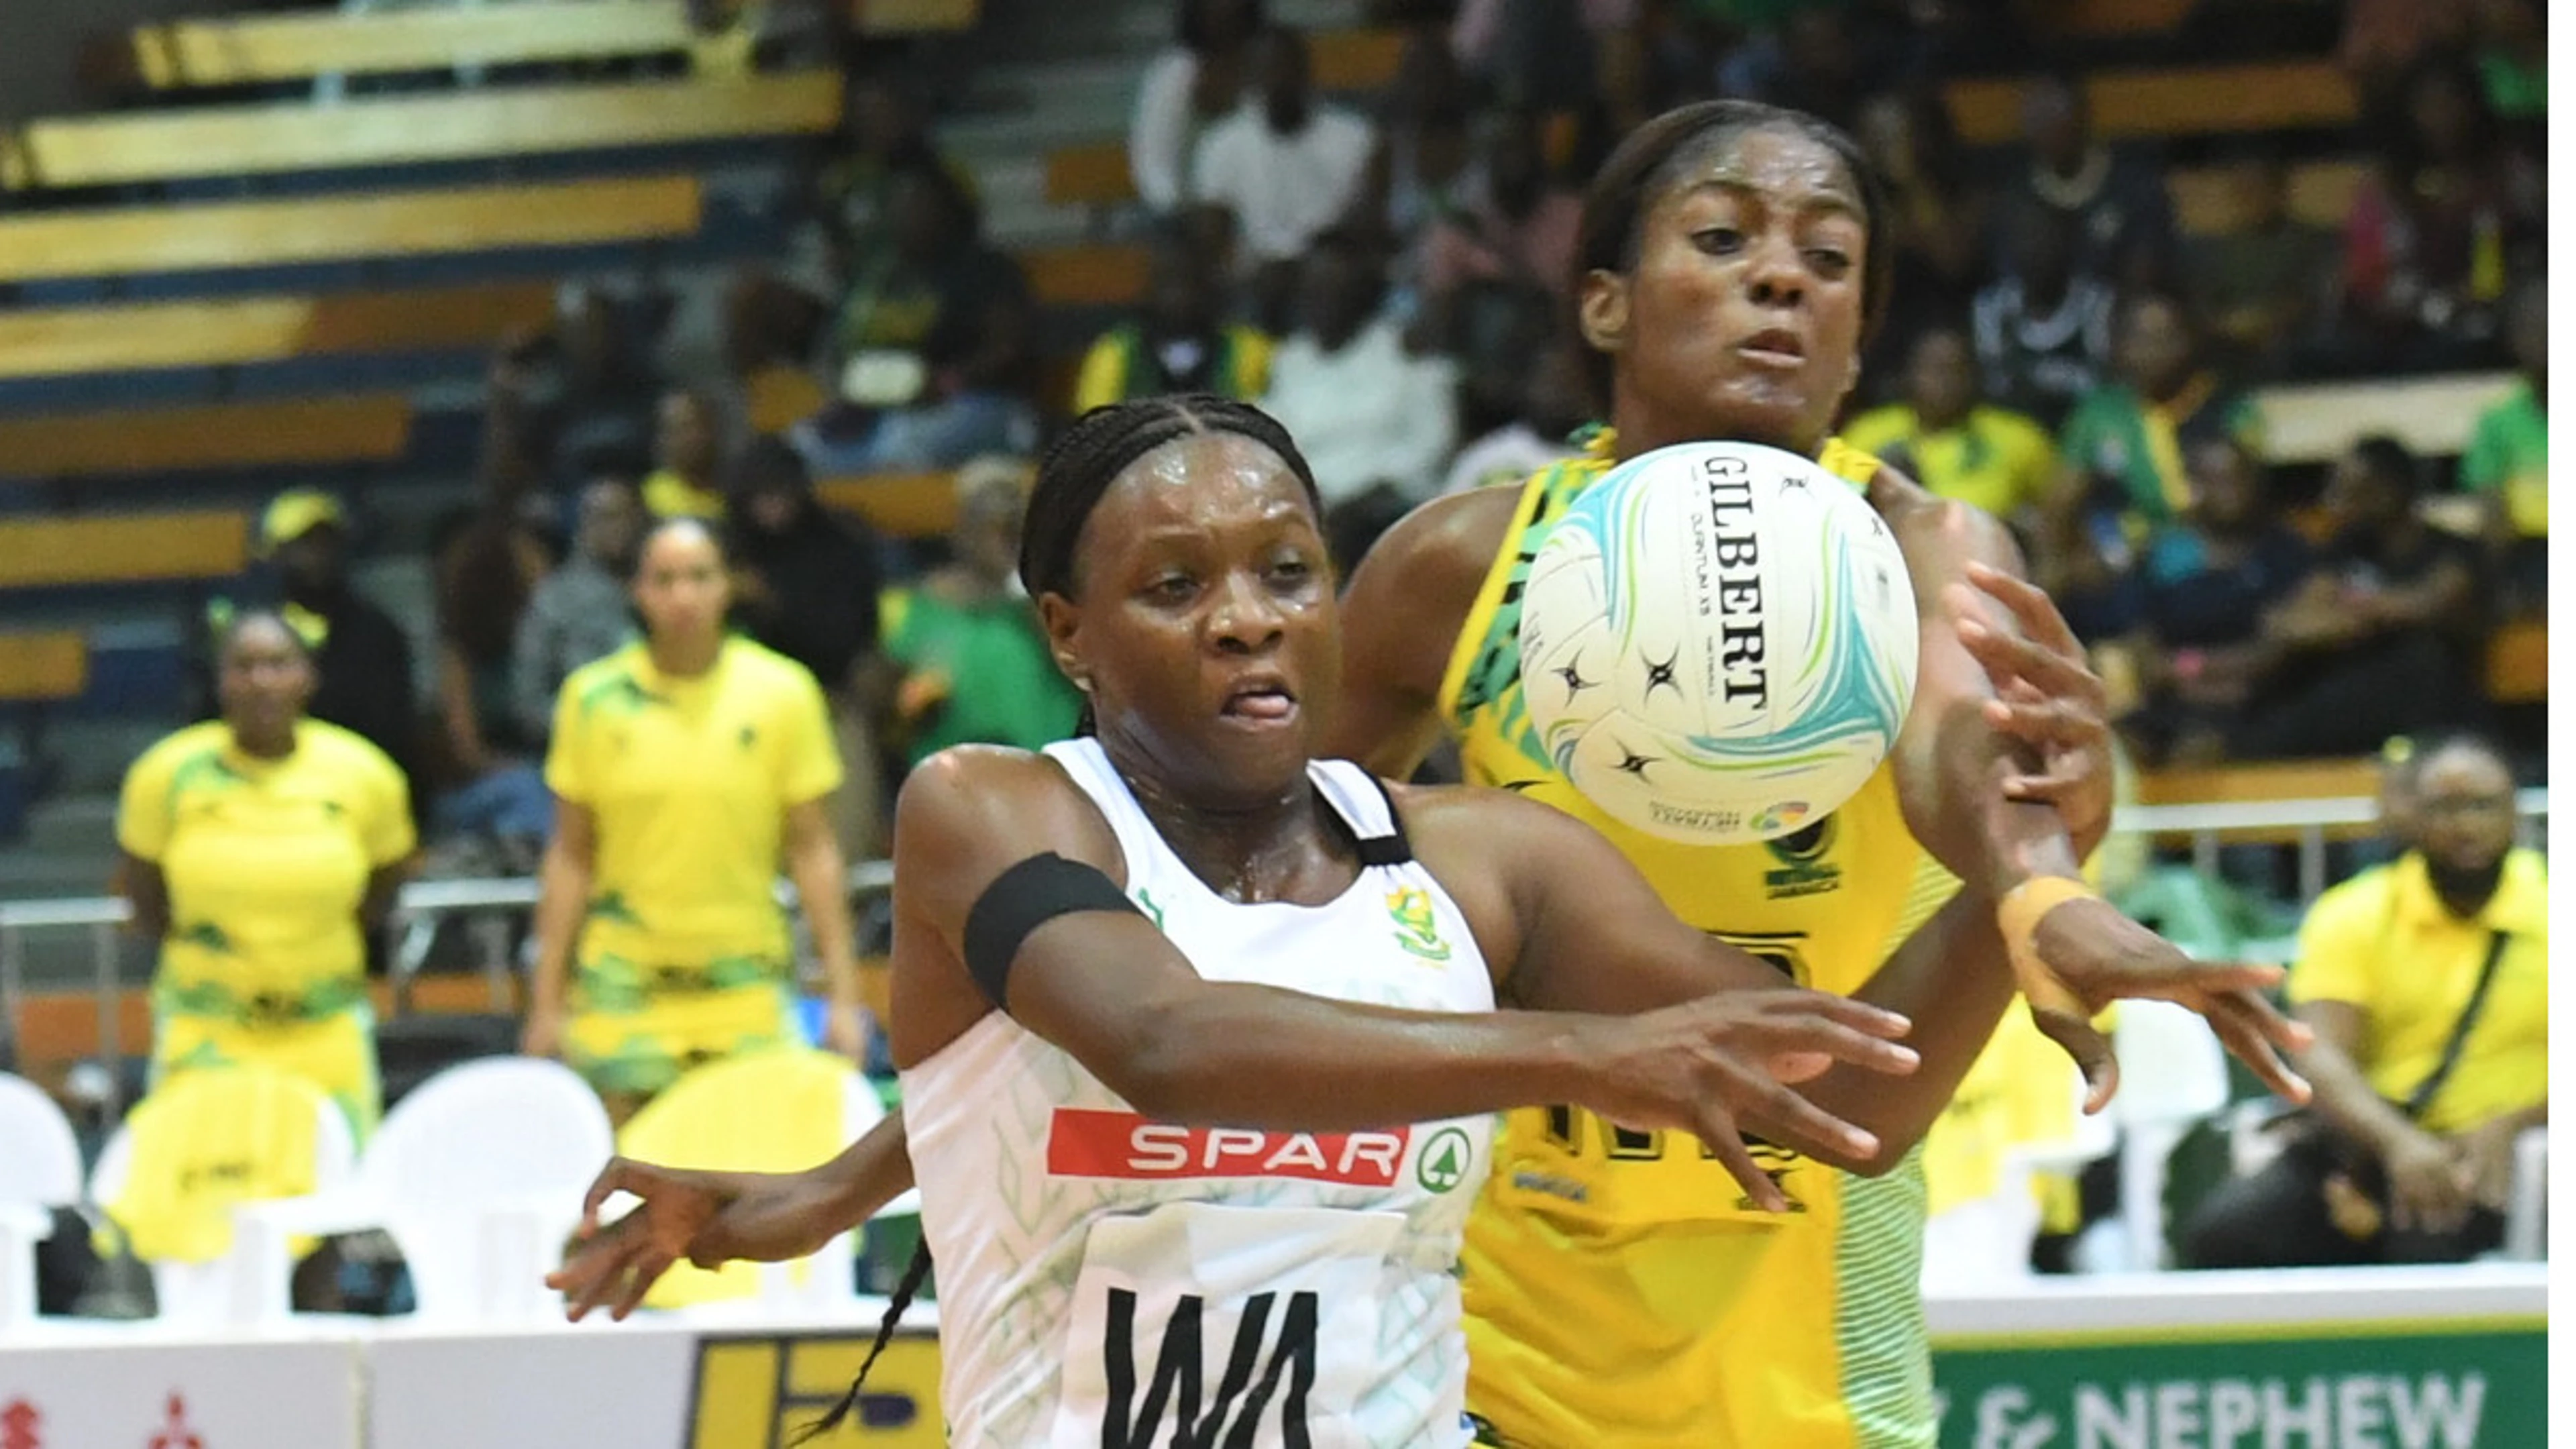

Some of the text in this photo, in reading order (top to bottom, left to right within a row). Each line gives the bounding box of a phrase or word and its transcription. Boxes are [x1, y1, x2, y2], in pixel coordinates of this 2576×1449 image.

[1704, 456, 1768, 710] GILBERT
[1128, 1124, 1402, 1177] SPAR
[1101, 1287, 1318, 1449] WA
[1974, 1386, 2055, 1449] &
[2074, 1373, 2487, 1449] NEPHEW
